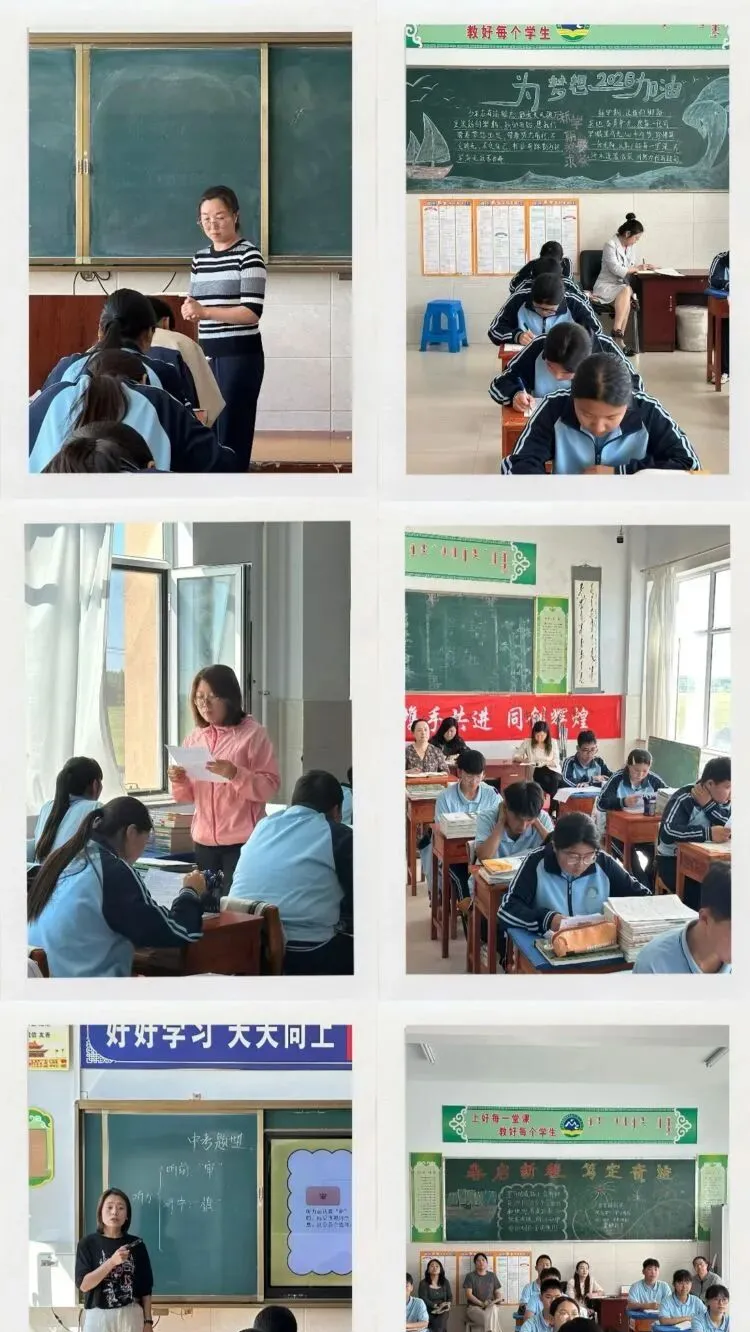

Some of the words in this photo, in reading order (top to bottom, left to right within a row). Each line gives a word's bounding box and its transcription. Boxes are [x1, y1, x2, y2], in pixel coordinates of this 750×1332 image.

[466, 25, 551, 40] 教好每个学生
[507, 706, 589, 730] 同创辉煌
[472, 1113, 531, 1124] 上好每一堂课
[498, 1127, 556, 1137] 教好每个学生
